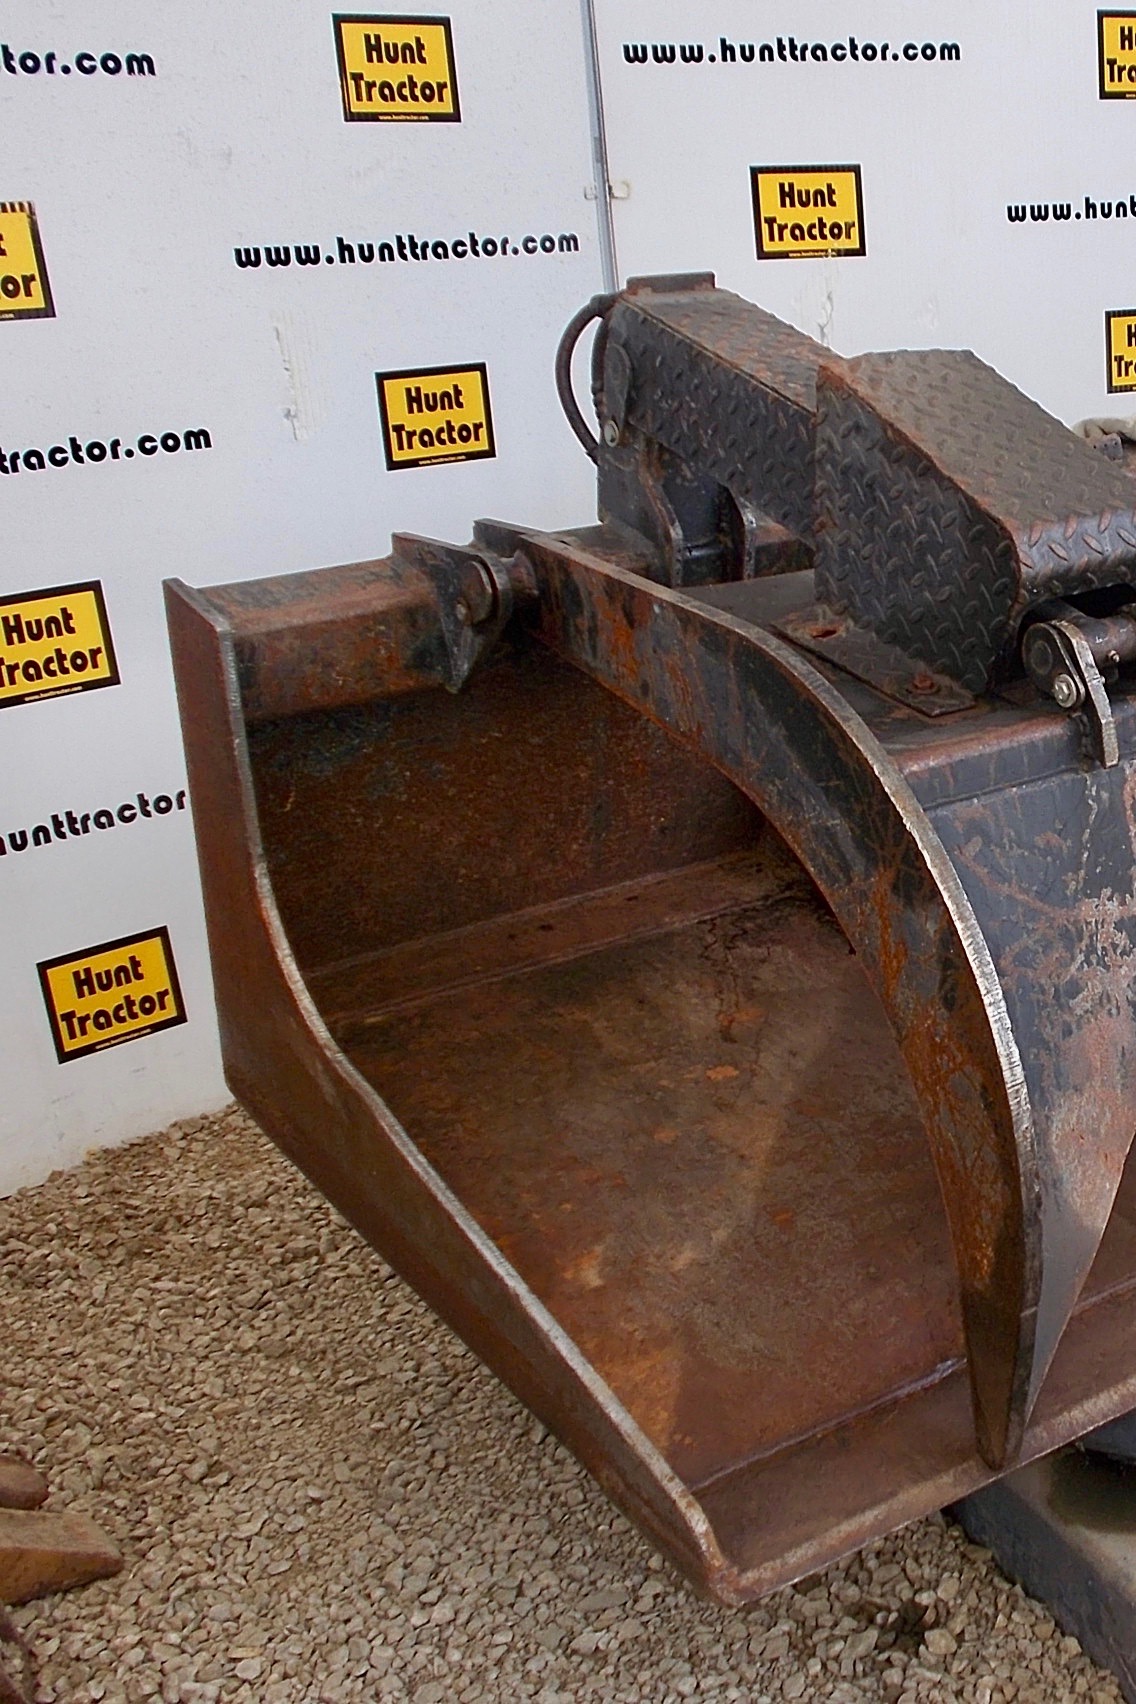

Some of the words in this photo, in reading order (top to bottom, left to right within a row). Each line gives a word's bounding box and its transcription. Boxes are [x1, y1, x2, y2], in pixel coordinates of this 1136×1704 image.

[364, 34, 427, 64] Hunt
[622, 37, 961, 64] www.hunttractor.com
[349, 73, 448, 103] Tractor
[778, 183, 837, 208] Hunt
[763, 217, 856, 242] Tractor
[234, 232, 580, 268] www.hunttractor.com
[405, 384, 464, 414] Hunt
[391, 420, 484, 450] Tractor
[1, 608, 75, 646] Hunt
[71, 956, 145, 999] Hunt
[59, 989, 170, 1040] Tractor
